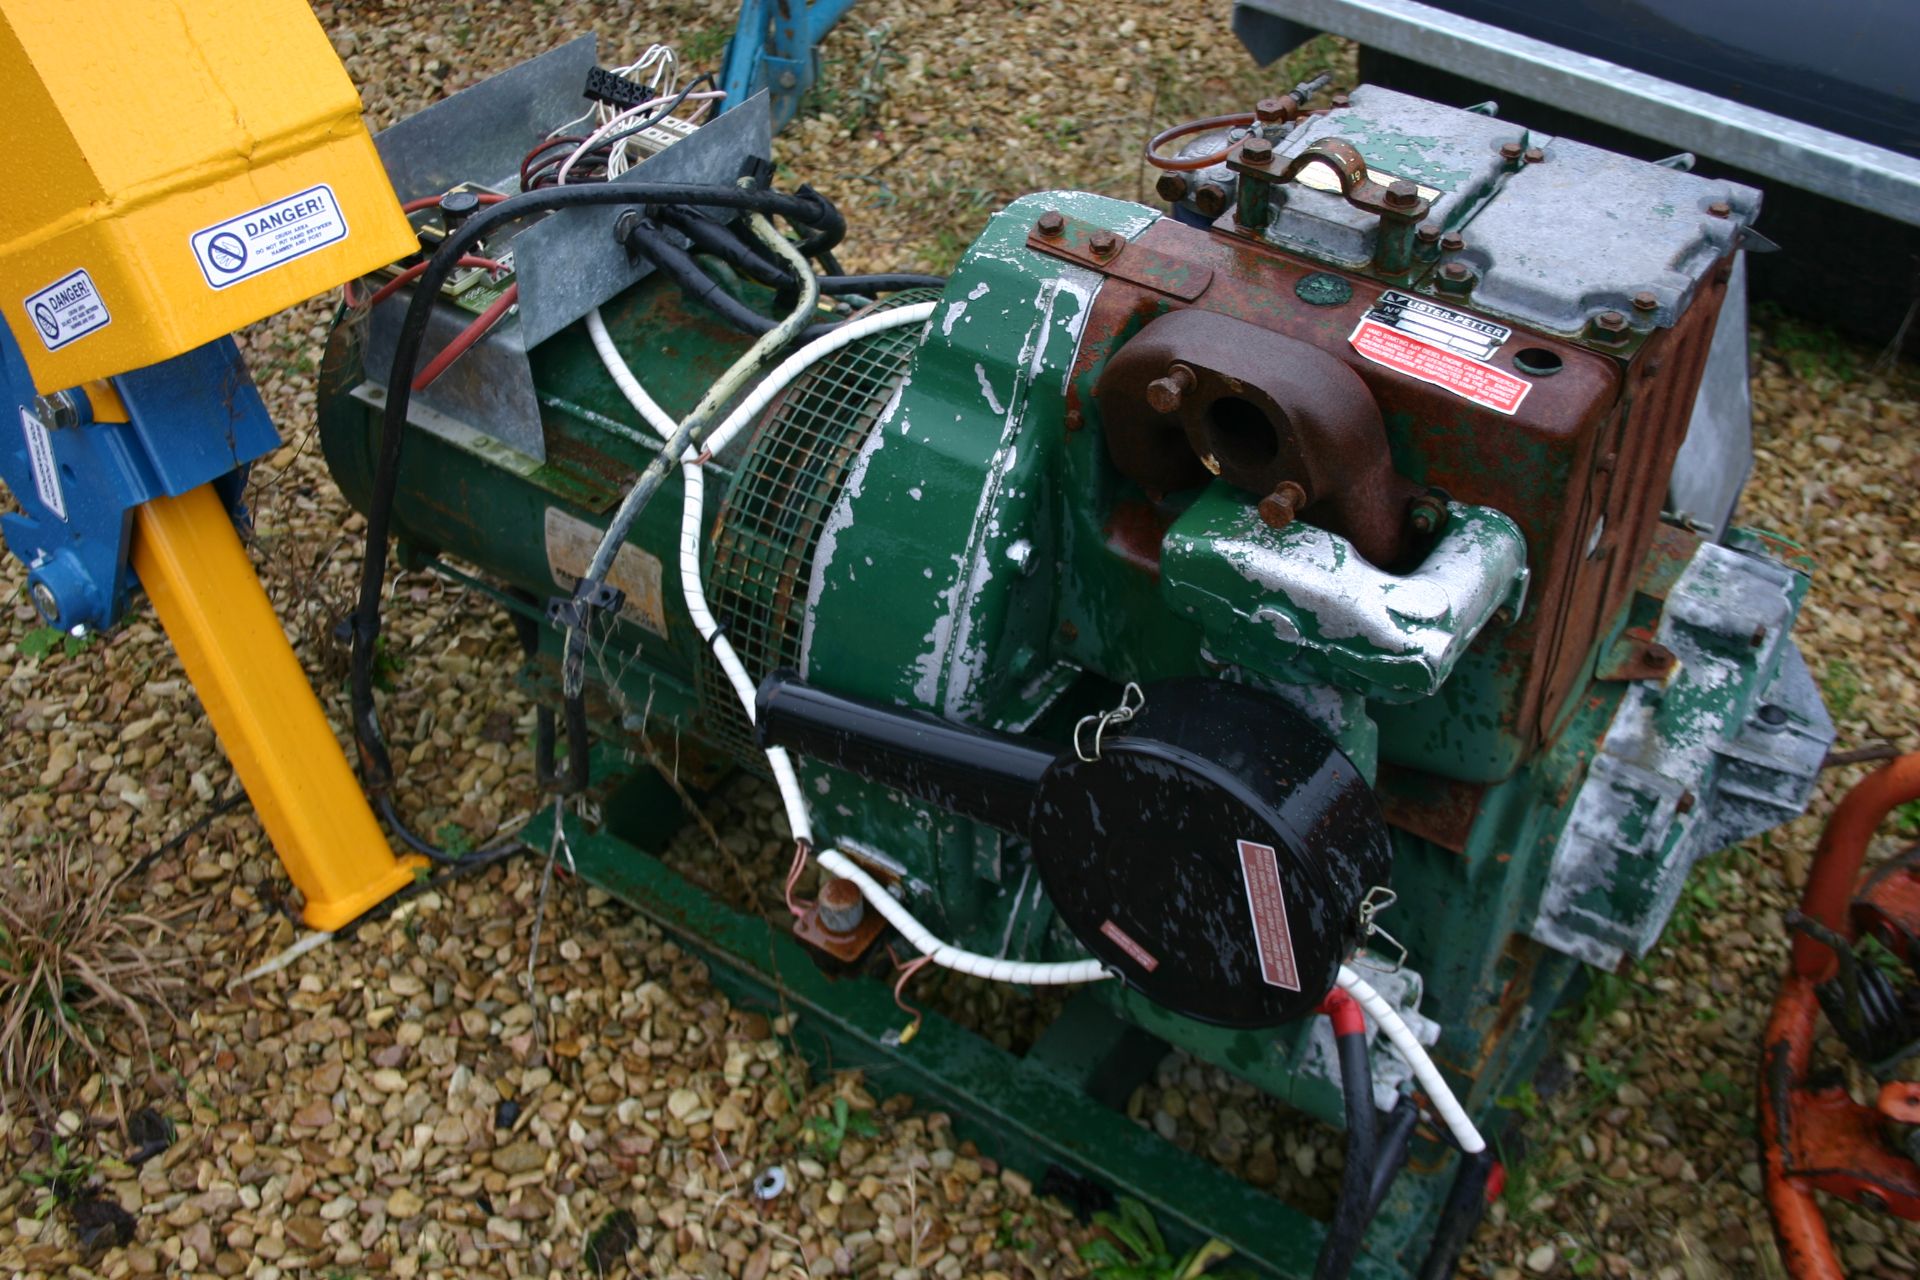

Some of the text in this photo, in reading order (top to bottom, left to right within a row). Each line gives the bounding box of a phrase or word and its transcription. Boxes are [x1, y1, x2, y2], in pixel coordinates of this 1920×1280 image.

[244, 196, 325, 238] DANGER!
[274, 223, 309, 240] CRUSH AREA
[266, 243, 277, 251] NOT
[289, 232, 305, 241] HAND
[306, 221, 332, 235] BETWEEN
[271, 232, 322, 256] HAMMER AND POST
[48, 280, 90, 311] DANGER!
[1406, 299, 1504, 337] LISTER-PETTER
[1359, 337, 1396, 354] OPERATORS
[1395, 351, 1414, 361] MUST
[1470, 380, 1484, 389] THE
[1484, 385, 1514, 400] CORRECT
[1371, 336, 1385, 344] THE
[1384, 341, 1407, 352] HANDS
[1494, 383, 1517, 395] ENGINE
[1382, 334, 1410, 347] STARTING
[1421, 348, 1442, 359] DIESEL
[1441, 356, 1463, 368] ENGINE
[1463, 364, 1477, 373] CAN
[1458, 381, 1477, 391] START
[1476, 388, 1489, 396] THIS
[1489, 393, 1511, 405] ENGINE
